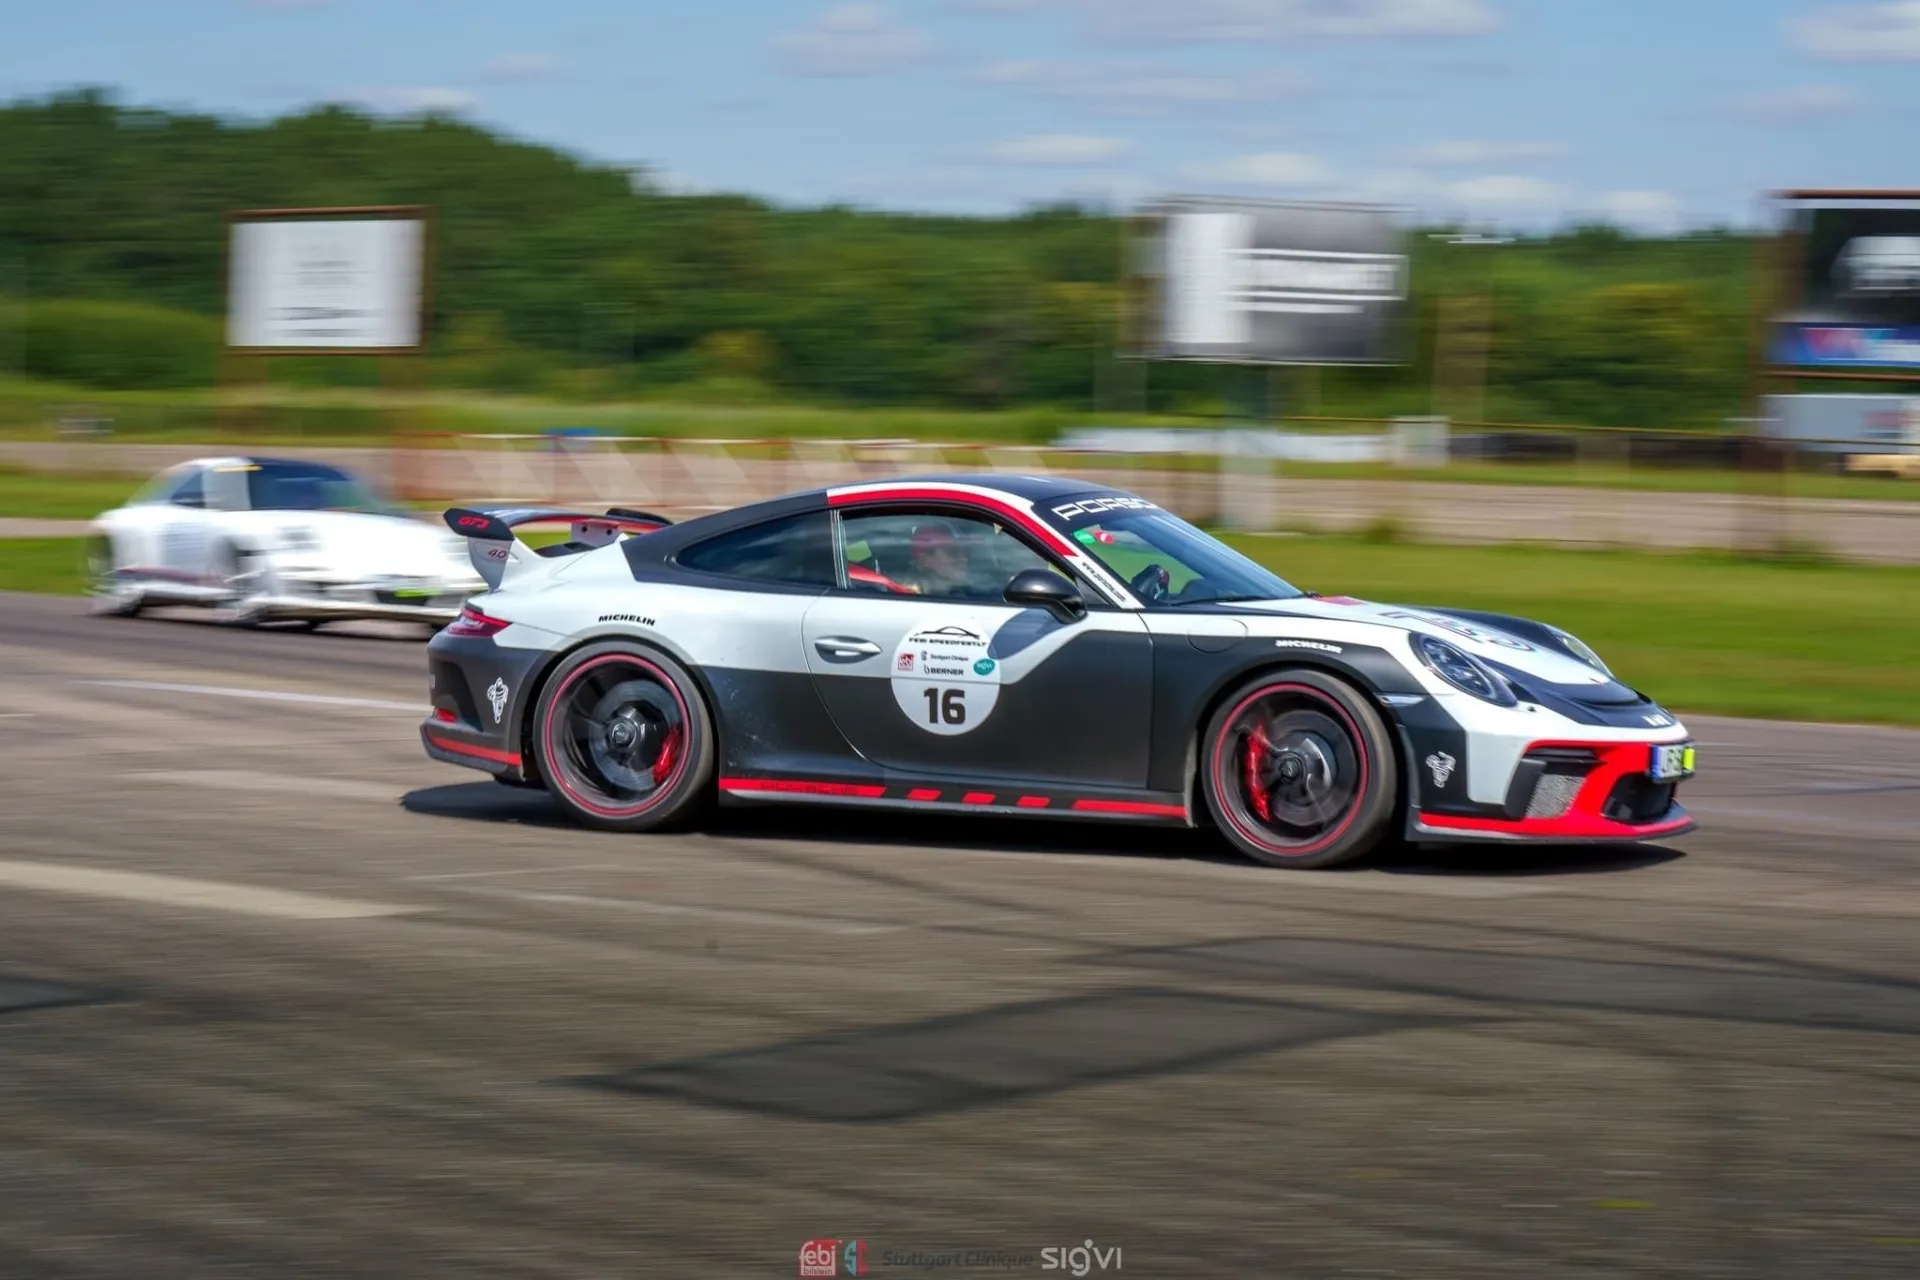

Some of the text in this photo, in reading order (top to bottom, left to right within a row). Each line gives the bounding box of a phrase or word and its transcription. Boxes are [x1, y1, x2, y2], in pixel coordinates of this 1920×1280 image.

[1051, 497, 1160, 521] PORSC
[598, 613, 656, 627] MICHELIN
[930, 668, 964, 676] BERNER
[923, 688, 966, 725] 16
